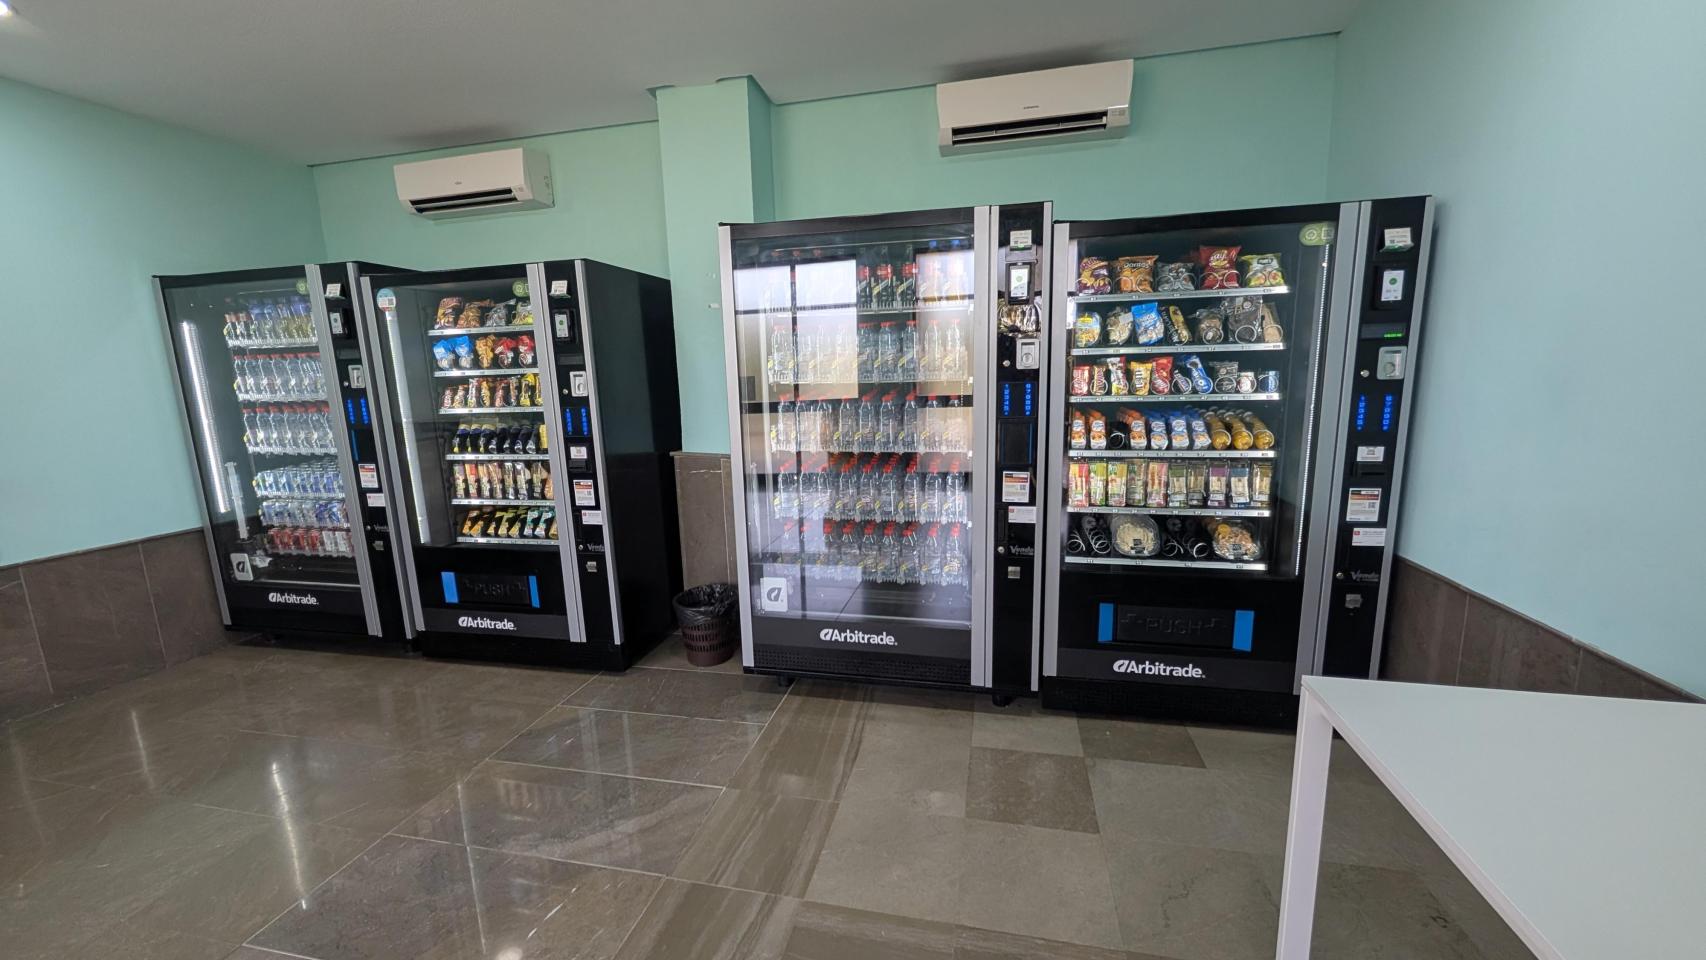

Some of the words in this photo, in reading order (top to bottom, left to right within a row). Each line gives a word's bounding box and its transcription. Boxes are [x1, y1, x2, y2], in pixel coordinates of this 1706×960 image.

[276, 592, 319, 605] Arbitrade
[467, 616, 517, 630] Arbitrade
[1146, 617, 1201, 636] PUSH
[831, 629, 898, 646] Arbitrade
[1126, 660, 1206, 679] Arbitrade
